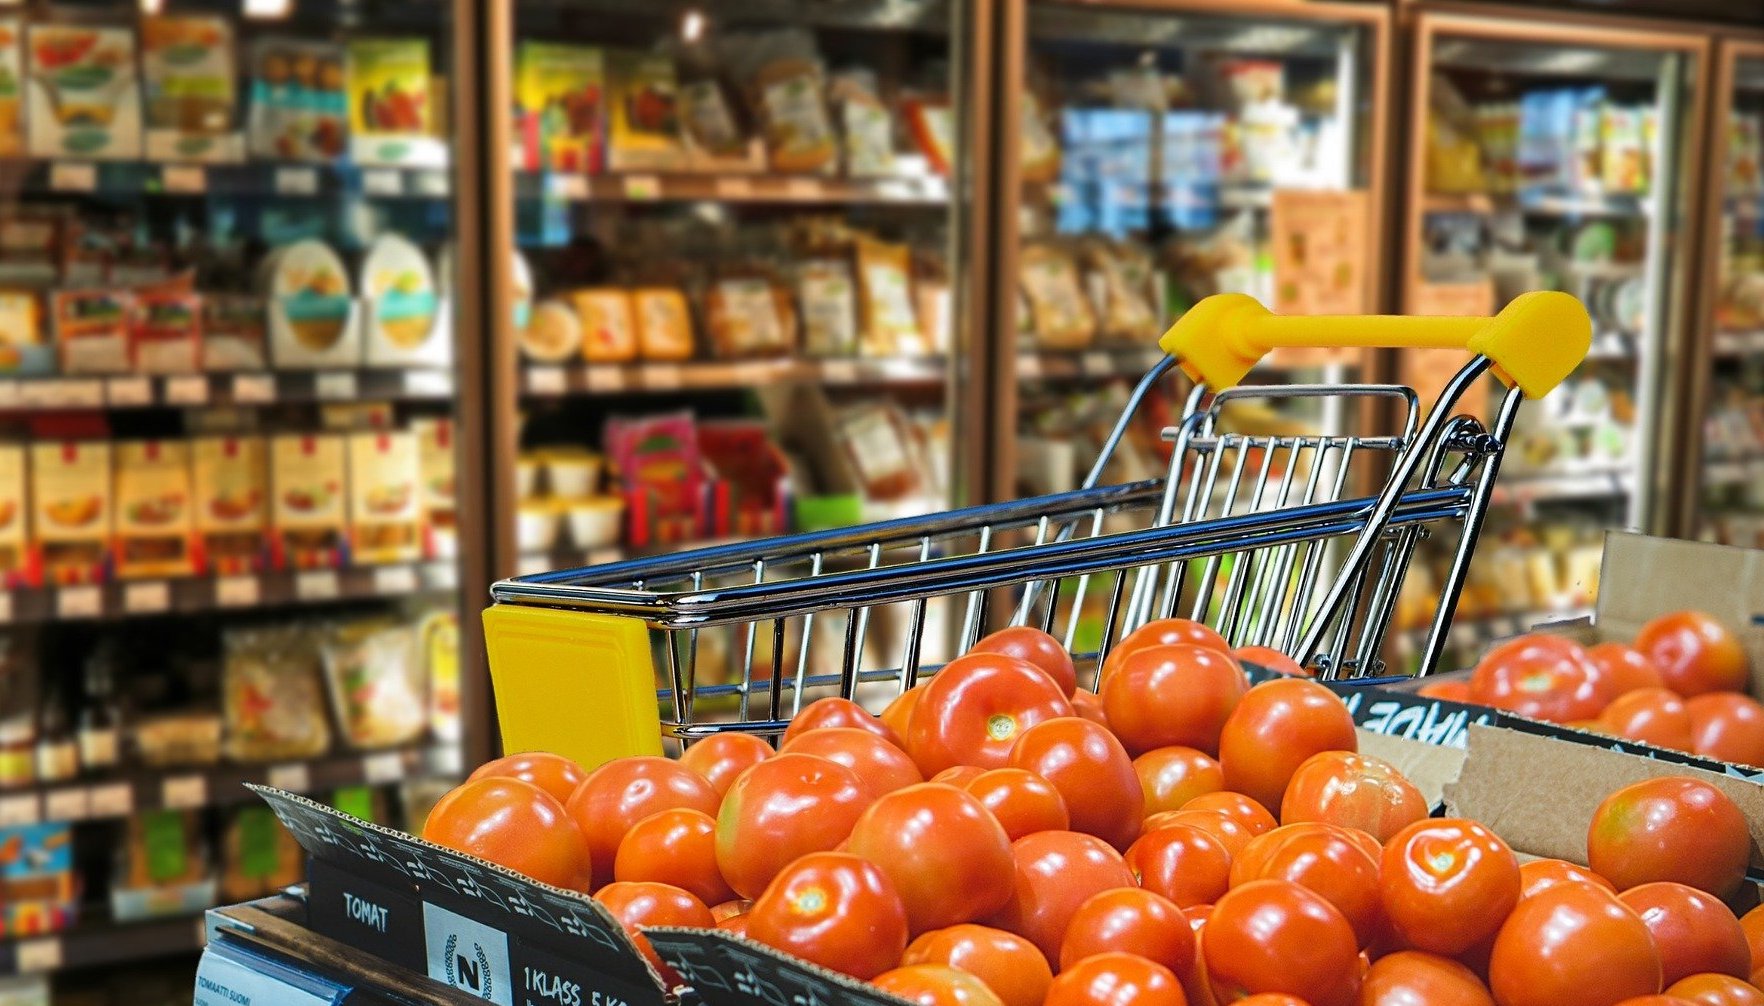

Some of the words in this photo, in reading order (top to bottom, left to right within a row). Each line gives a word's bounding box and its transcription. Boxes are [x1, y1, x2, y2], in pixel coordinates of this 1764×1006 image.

[343, 892, 388, 933] TOMAT
[198, 975, 229, 997] TOMAATTI
[456, 953, 480, 991] N
